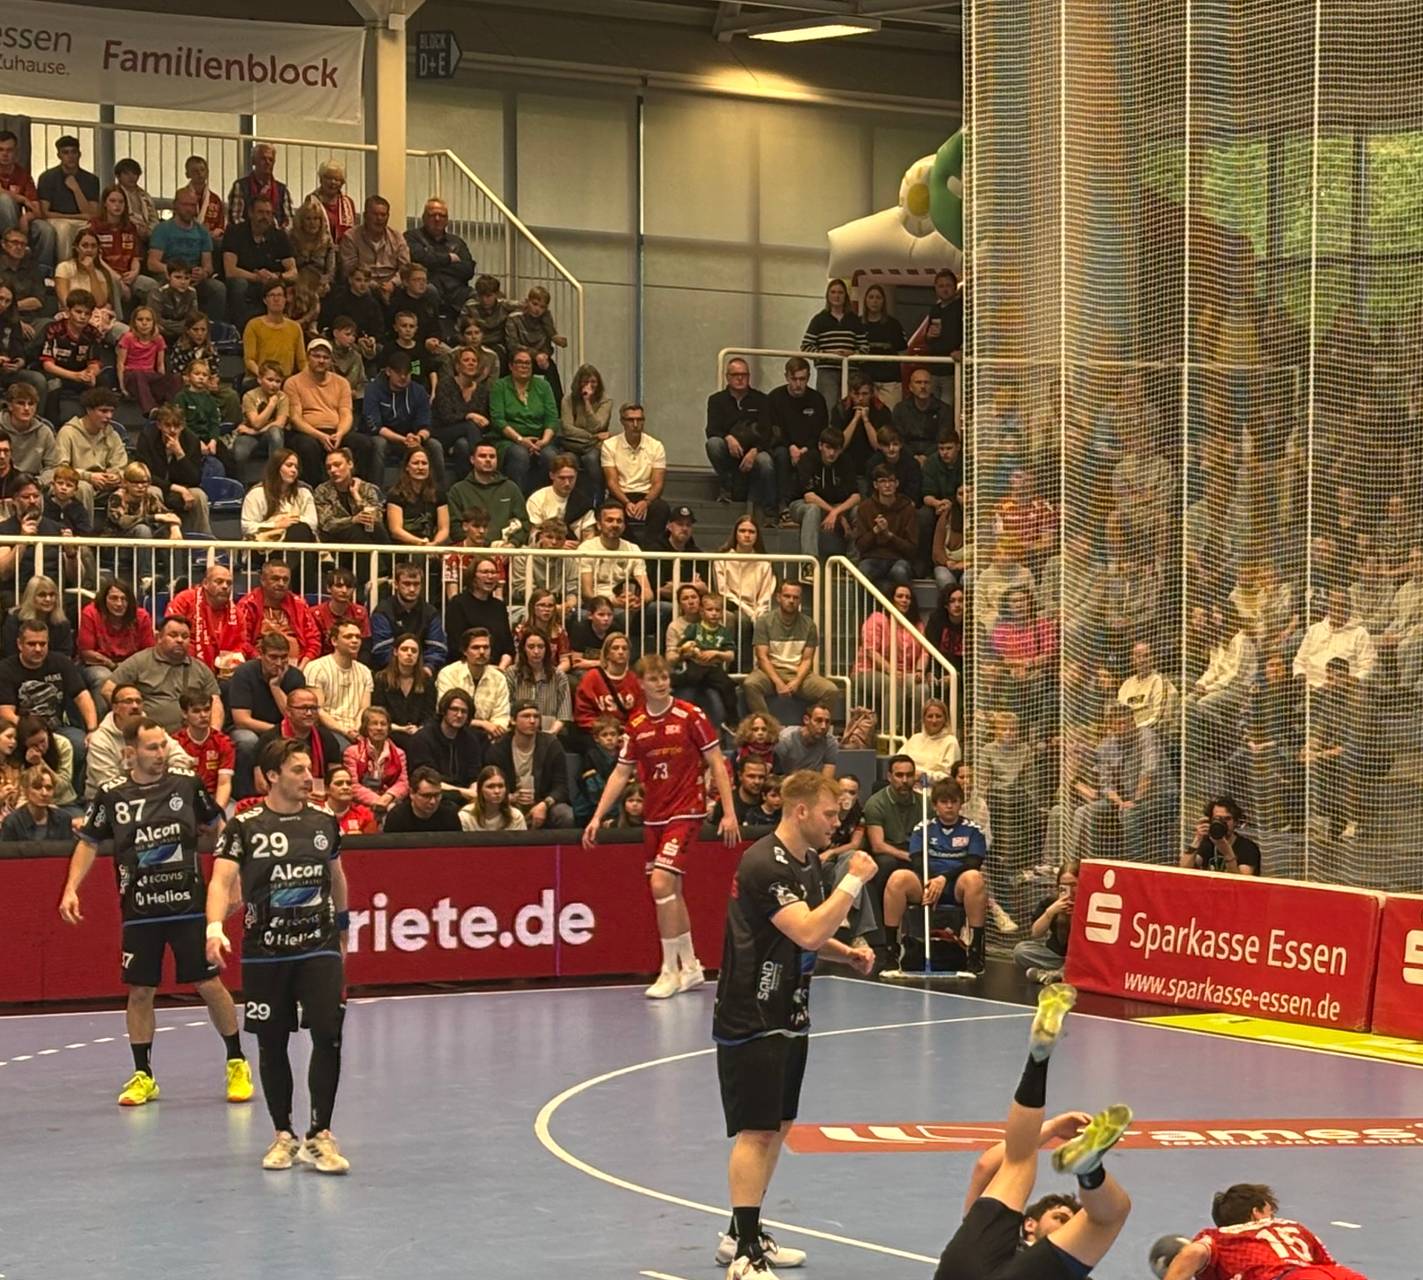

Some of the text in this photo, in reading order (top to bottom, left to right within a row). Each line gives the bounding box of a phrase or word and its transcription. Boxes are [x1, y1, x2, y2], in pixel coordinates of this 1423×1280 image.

[0, 26, 72, 53] ssen
[0, 54, 71, 76] uhause.
[103, 40, 338, 88] Familienblock
[115, 798, 146, 824] 87
[134, 823, 180, 843] Alcon
[251, 832, 288, 858] 29
[270, 864, 323, 881] Alcon
[147, 890, 191, 905] Helios
[1130, 912, 1347, 976] Sparkasse Essen
[757, 961, 774, 1000] SAND
[1124, 971, 1340, 1021] www.sparkasse-essen.de
[246, 1001, 271, 1020] 29
[1255, 1226, 1313, 1262] 15
